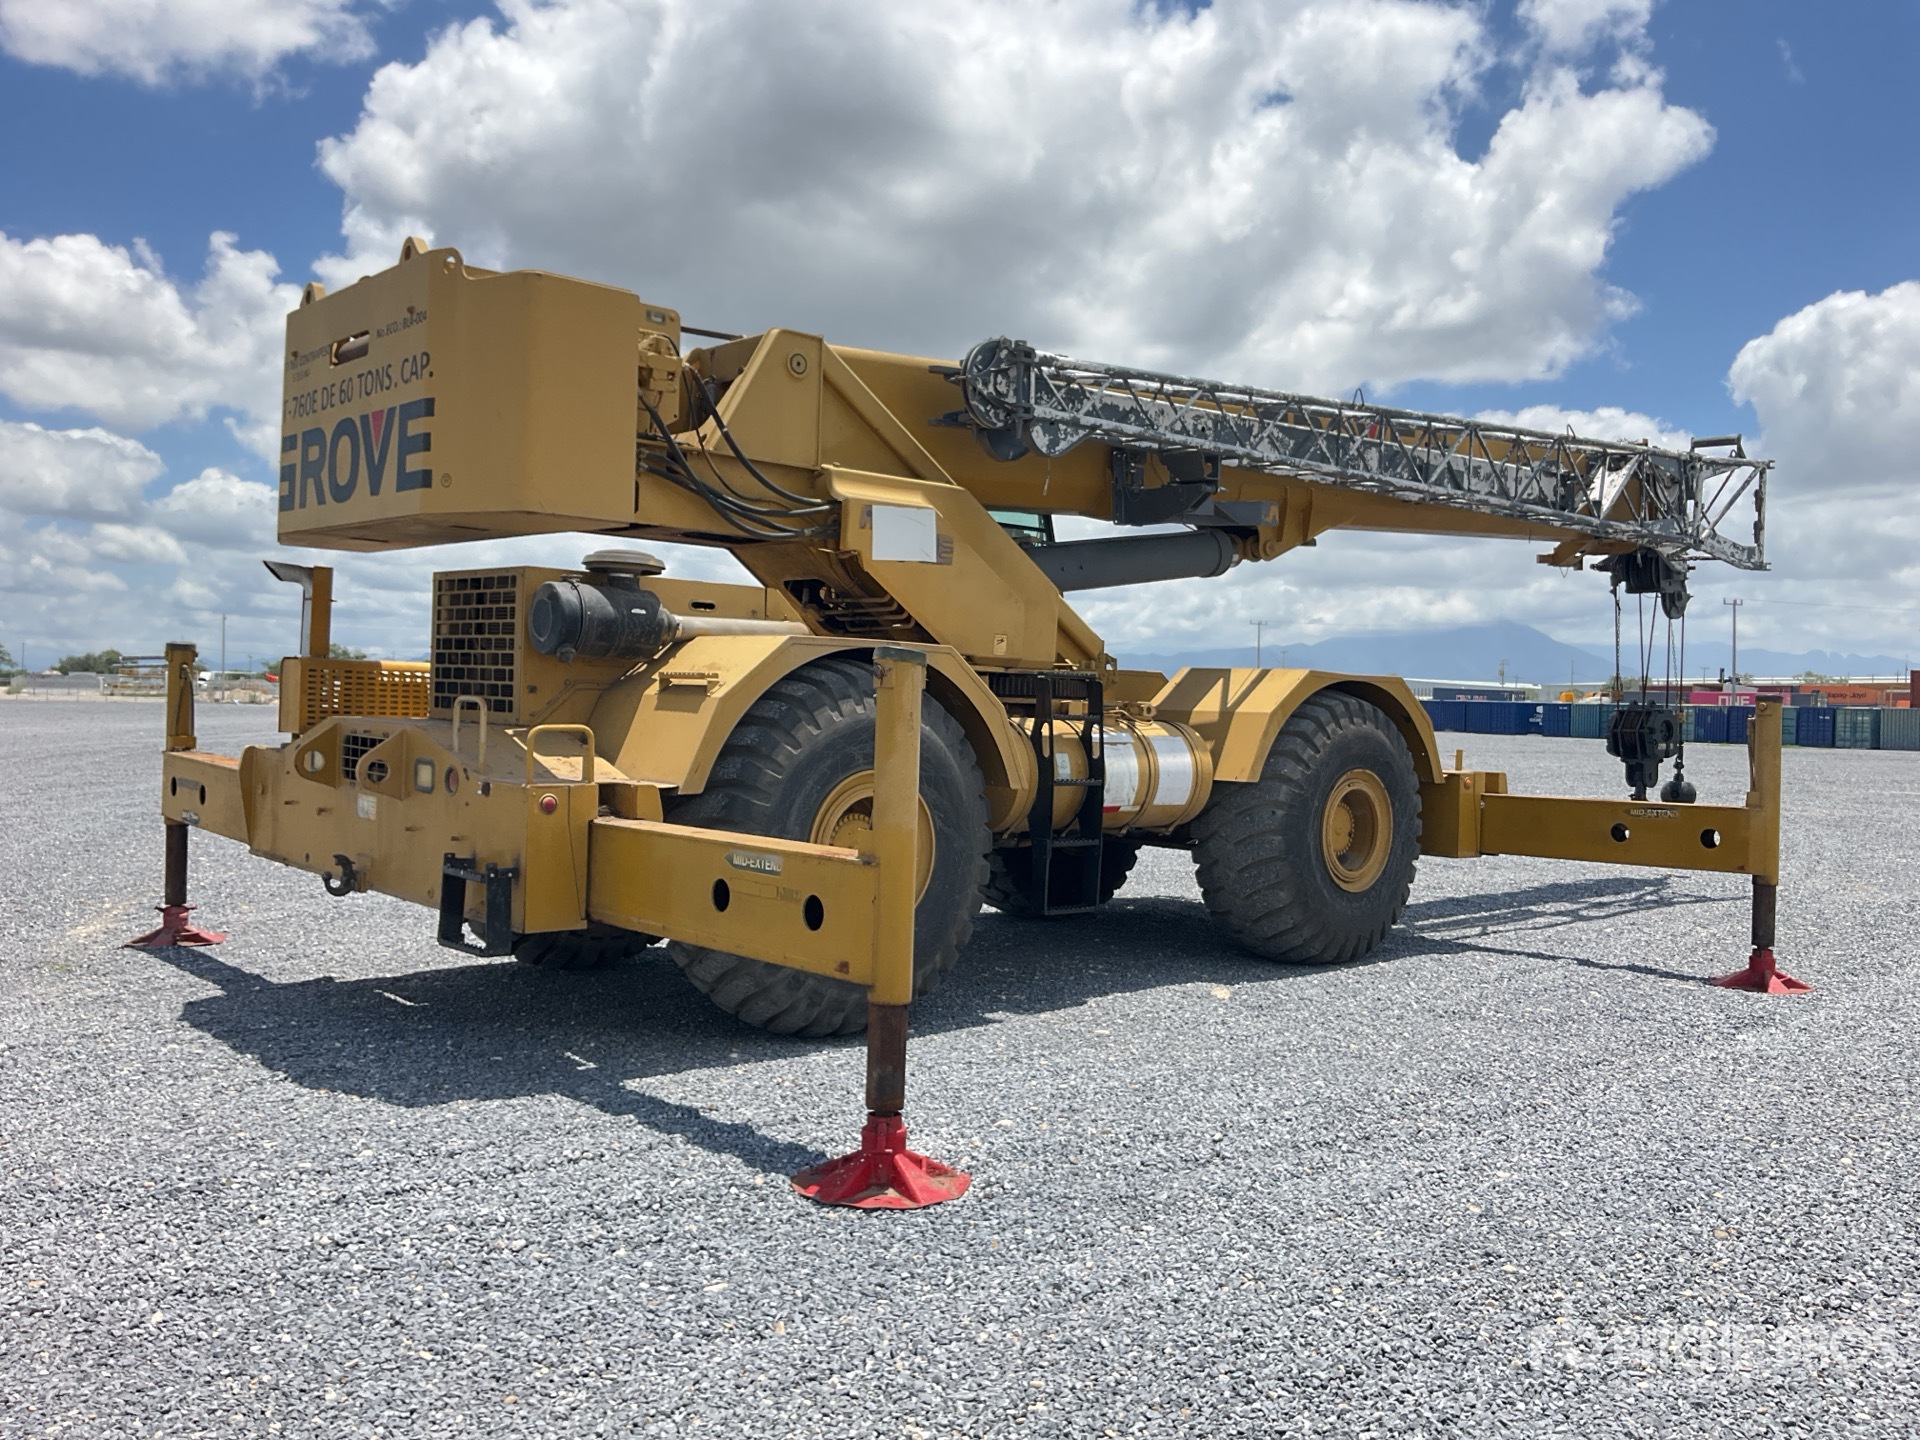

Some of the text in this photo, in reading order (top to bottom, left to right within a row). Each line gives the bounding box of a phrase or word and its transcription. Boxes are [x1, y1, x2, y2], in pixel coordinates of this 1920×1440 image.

[321, 382, 337, 411] DE
[339, 376, 354, 404] 60
[401, 351, 434, 385] CAP.
[279, 397, 436, 513] GROVE
